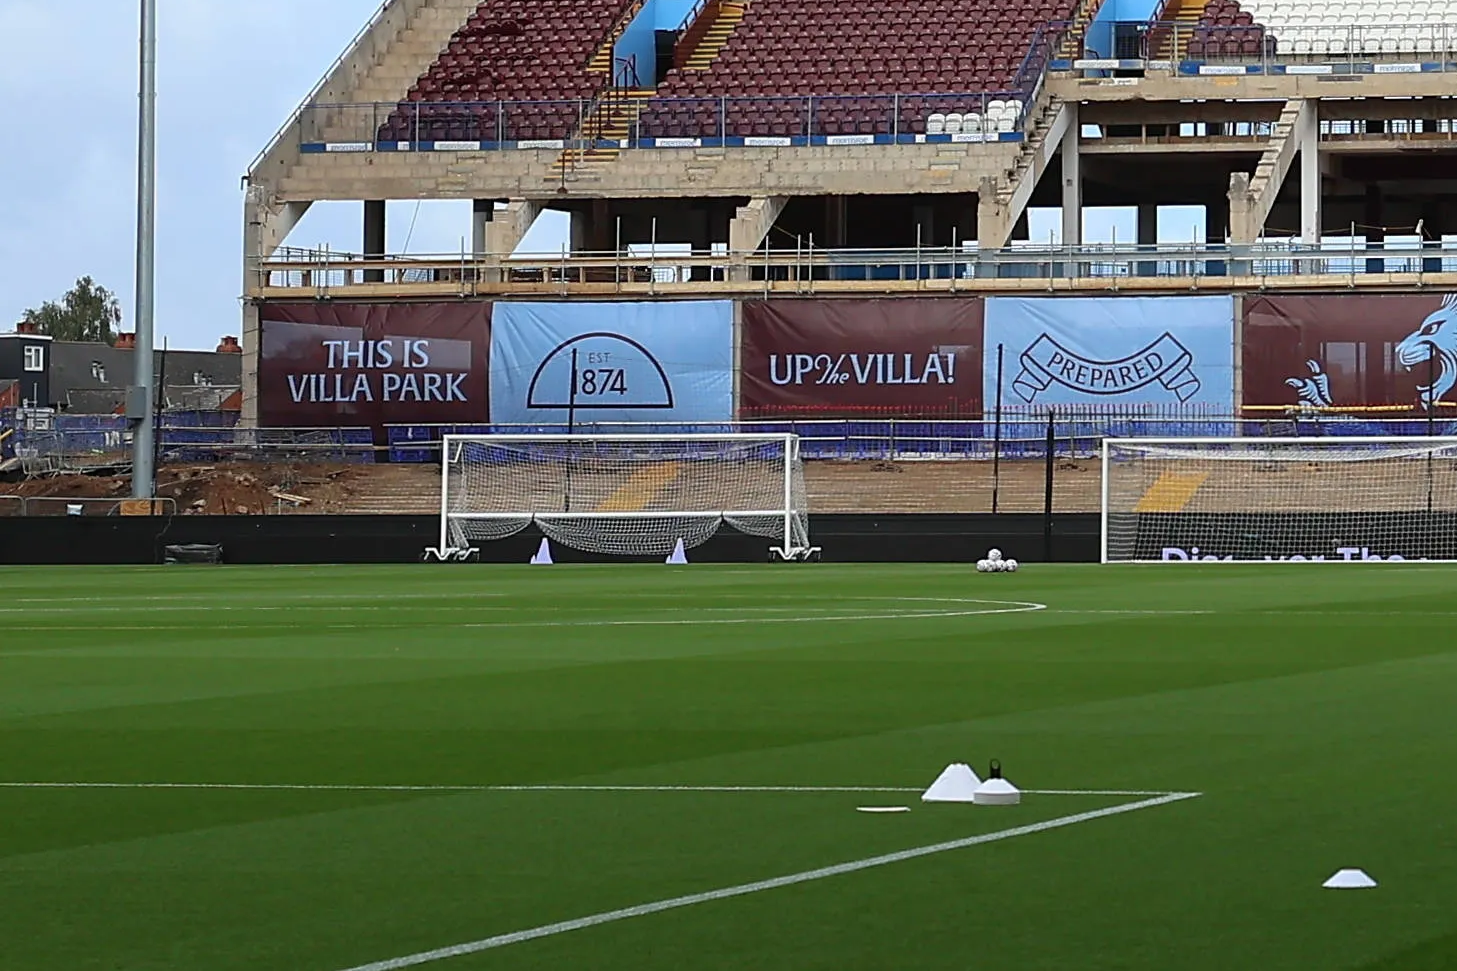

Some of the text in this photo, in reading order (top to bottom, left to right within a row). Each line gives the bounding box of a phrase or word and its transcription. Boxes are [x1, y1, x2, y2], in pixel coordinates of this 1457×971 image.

[322, 340, 429, 368] THIS IS
[588, 353, 611, 364] EST
[769, 353, 956, 384] UP The VILLA!
[1047, 352, 1163, 387] PREPARED
[287, 372, 468, 403] VILLA PARK
